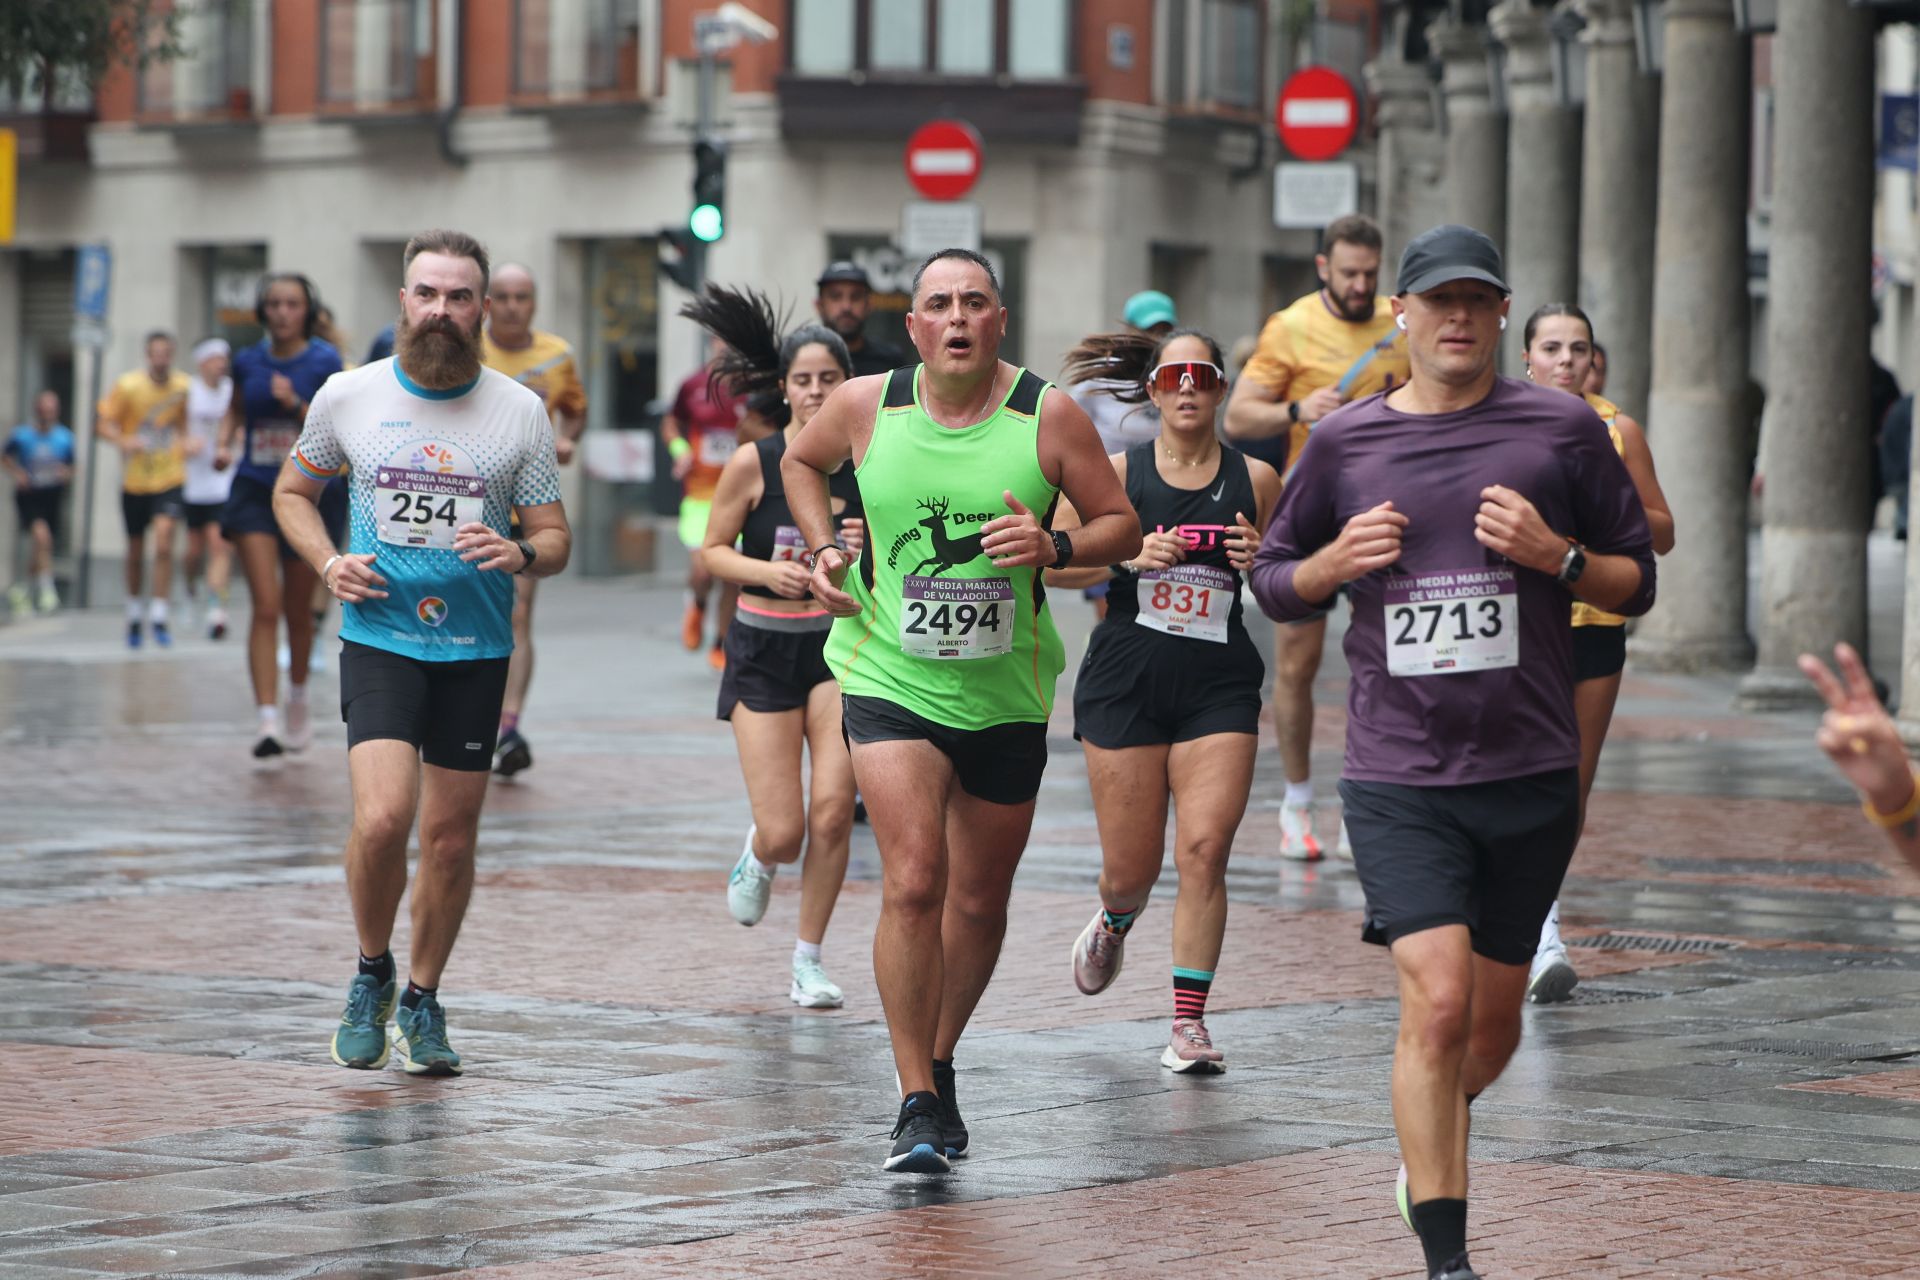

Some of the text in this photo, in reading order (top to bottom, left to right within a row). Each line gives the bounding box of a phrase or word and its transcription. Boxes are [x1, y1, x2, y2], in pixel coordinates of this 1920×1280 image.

[406, 472, 436, 483] MEDIA
[397, 481, 470, 496] DE VALLADOLID
[390, 492, 457, 527] 254
[887, 527, 922, 570] Running
[952, 511, 996, 525] Deer
[905, 579, 1010, 590] XXXVI MEDIA MARATÓN
[1174, 574, 1223, 588] VALLADOLID
[1416, 575, 1454, 588] MEDIA
[1457, 569, 1513, 584] MARATÓN
[923, 591, 1000, 601] DE VALLADOLID
[1151, 581, 1211, 618] 831
[1409, 584, 1499, 601] DE VALLADOLID
[905, 601, 1000, 635] 2494
[1393, 599, 1502, 646] 2713
